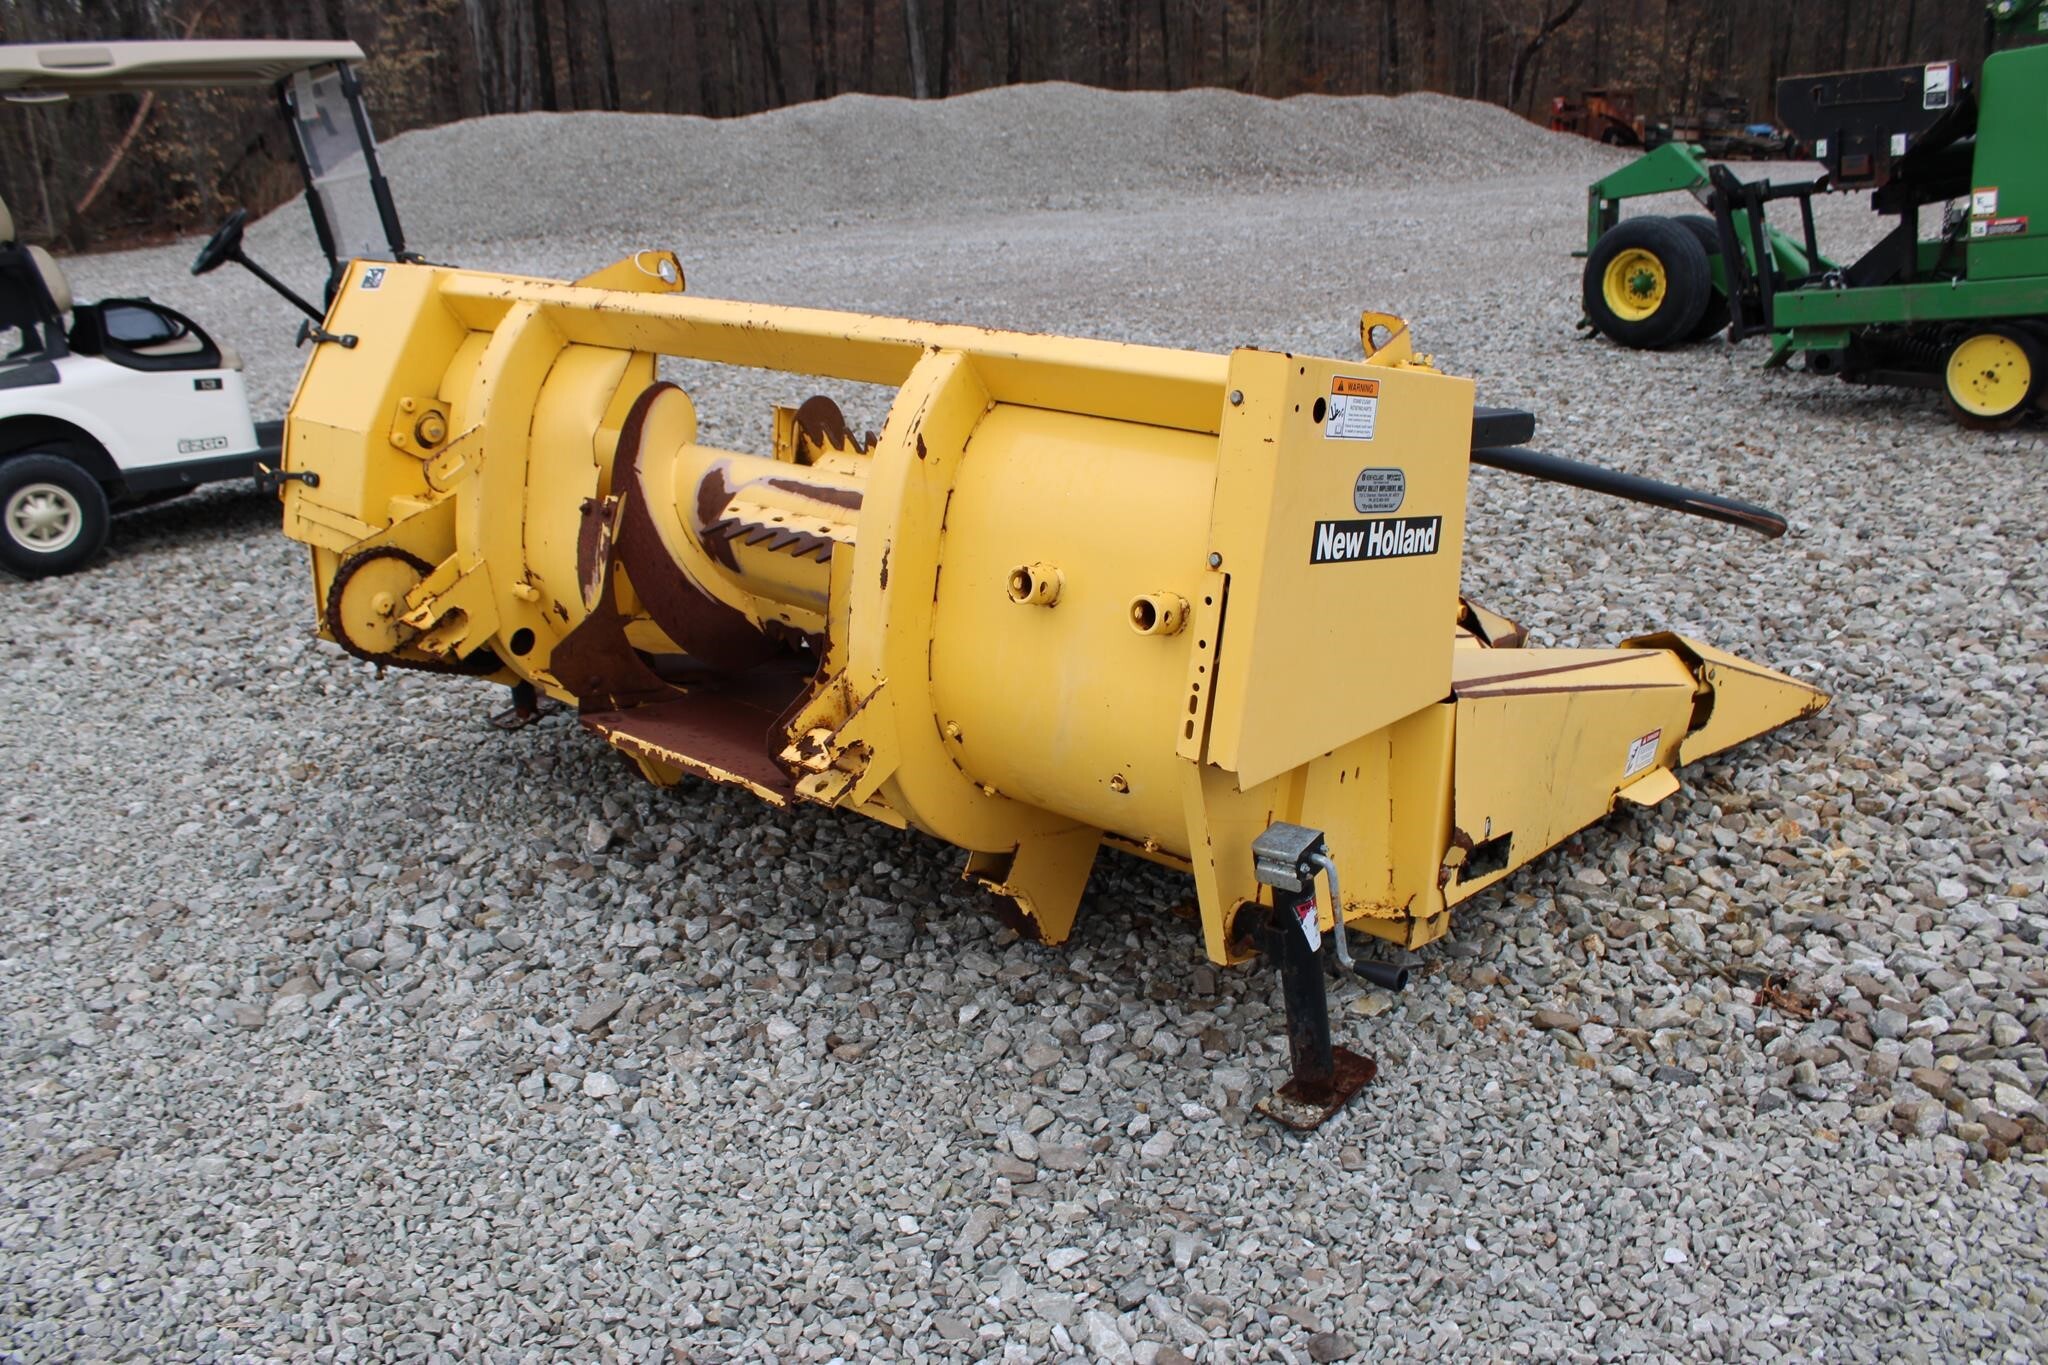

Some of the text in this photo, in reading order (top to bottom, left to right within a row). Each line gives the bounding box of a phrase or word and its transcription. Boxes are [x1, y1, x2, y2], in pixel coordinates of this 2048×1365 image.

[1348, 383, 1374, 393] WARNING
[1316, 518, 1437, 560] New Holland
